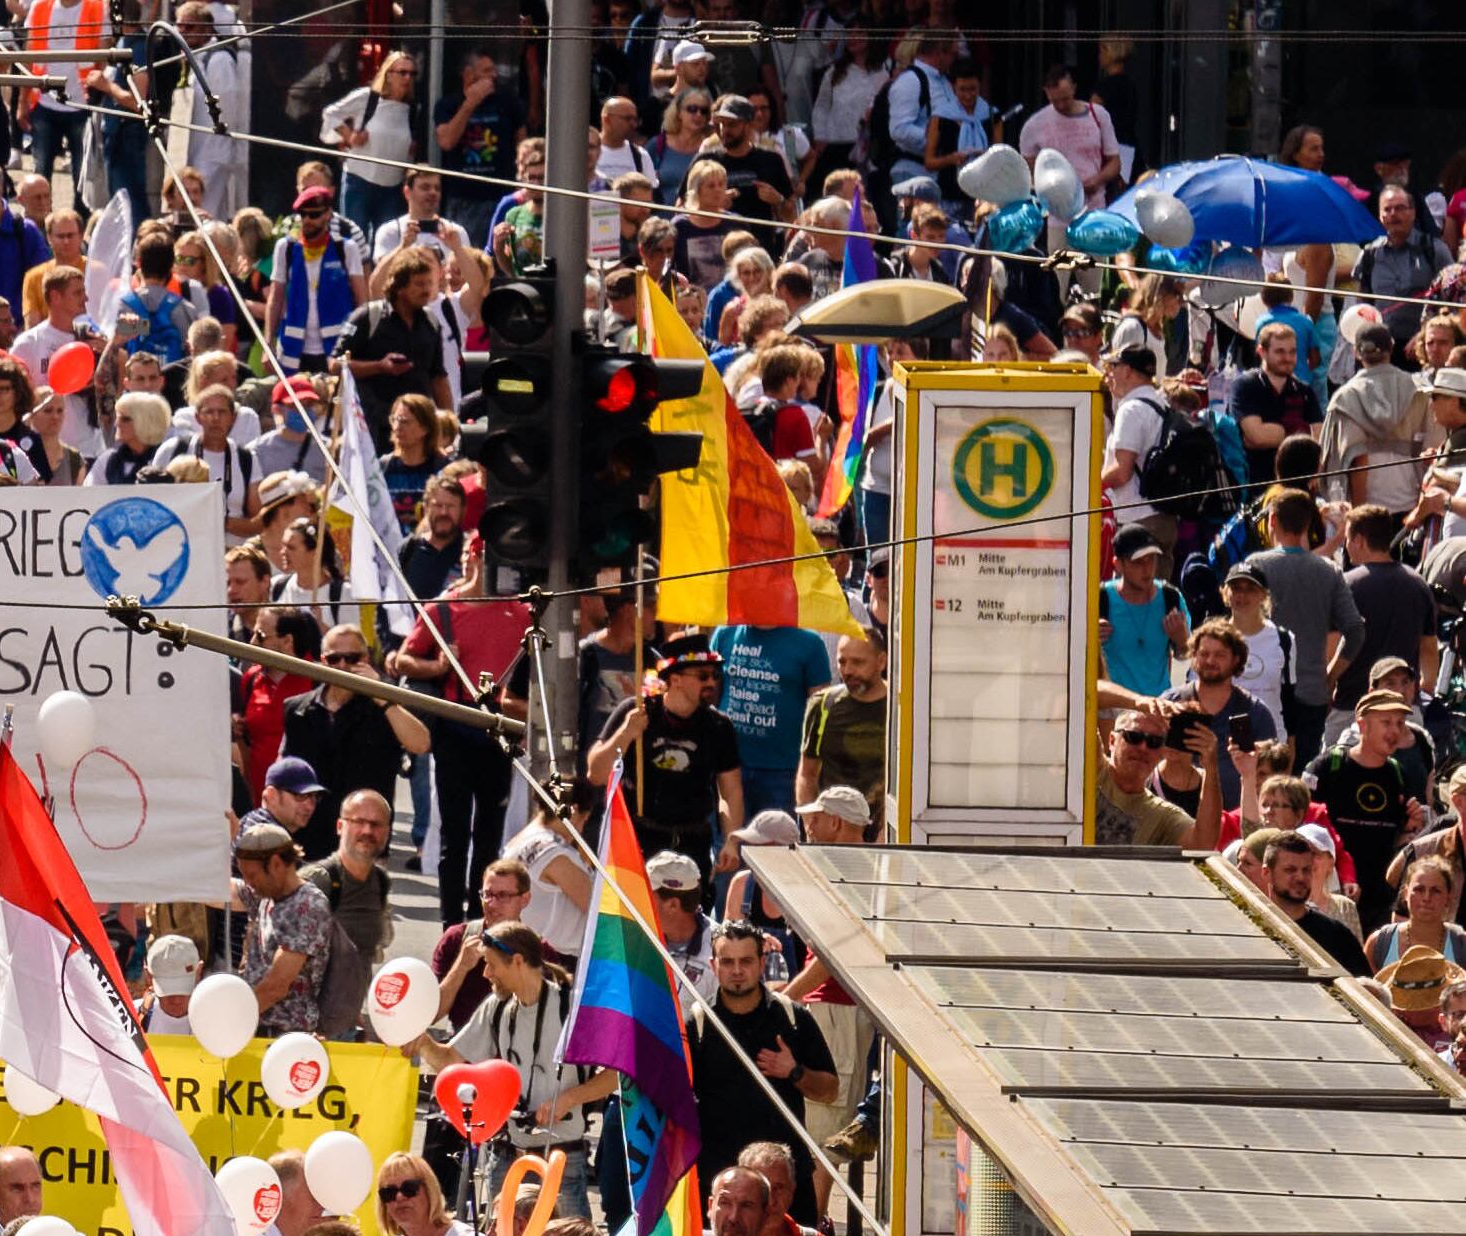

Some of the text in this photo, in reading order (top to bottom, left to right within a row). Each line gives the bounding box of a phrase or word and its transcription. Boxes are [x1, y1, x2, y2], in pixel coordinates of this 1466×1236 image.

[980, 442, 1028, 497] H
[947, 553, 1006, 567] M1 Mitte
[978, 566, 1066, 578] Am Kupfergraben
[947, 599, 1005, 612] 12 Mitte
[977, 612, 1066, 624] Am Kupfergraben
[732, 643, 762, 657] Heal
[727, 664, 780, 683] Cleanse
[729, 685, 760, 702] Raise
[753, 716, 777, 727] out
[217, 1079, 361, 1128] KRG,
